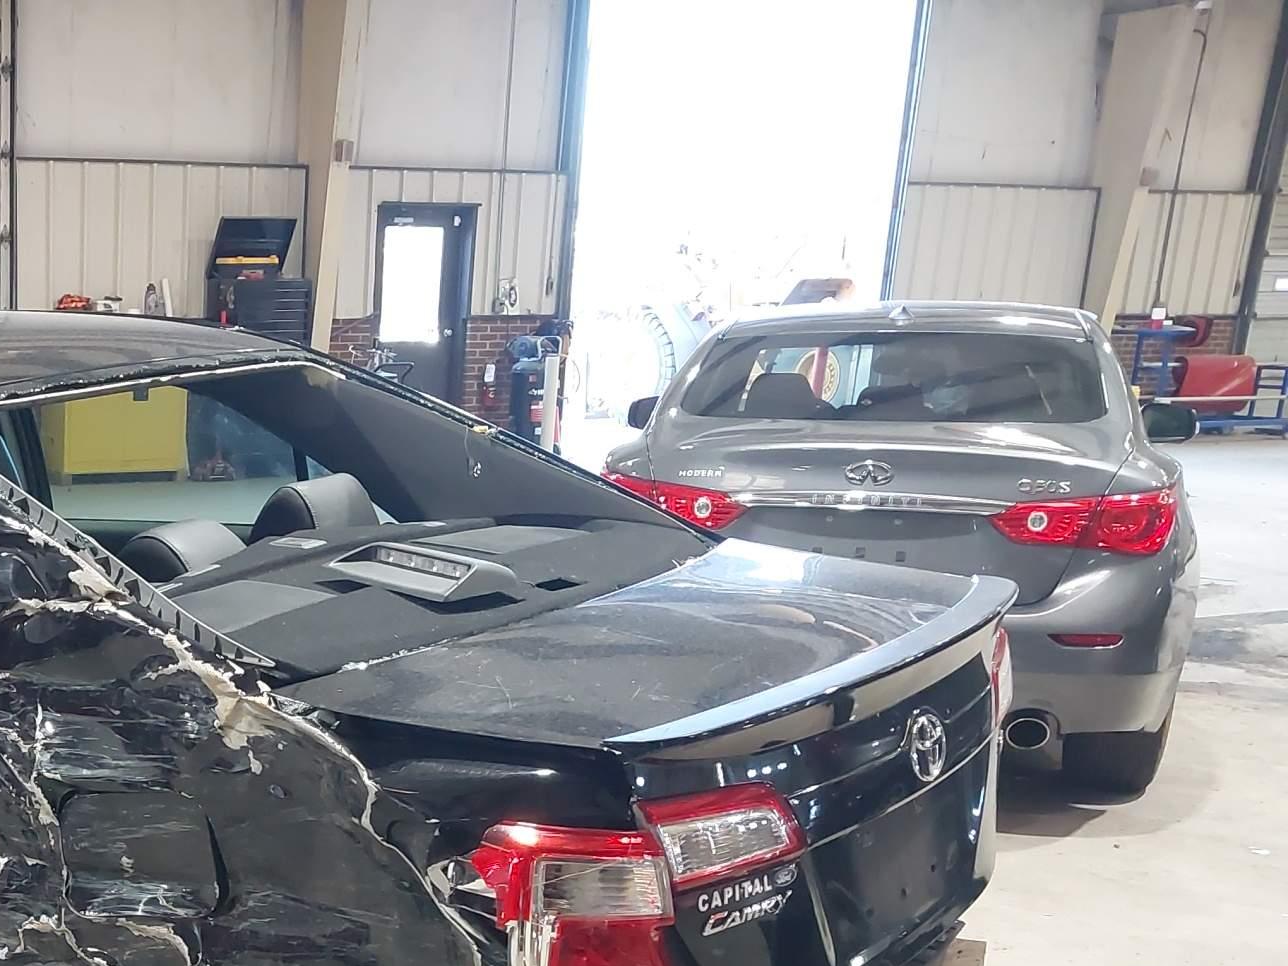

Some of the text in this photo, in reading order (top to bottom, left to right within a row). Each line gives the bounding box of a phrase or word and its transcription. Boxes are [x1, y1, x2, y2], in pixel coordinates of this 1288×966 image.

[678, 469, 723, 478] MODERN
[697, 874, 773, 912] CAPITAL
[702, 890, 793, 937] CAMRY
